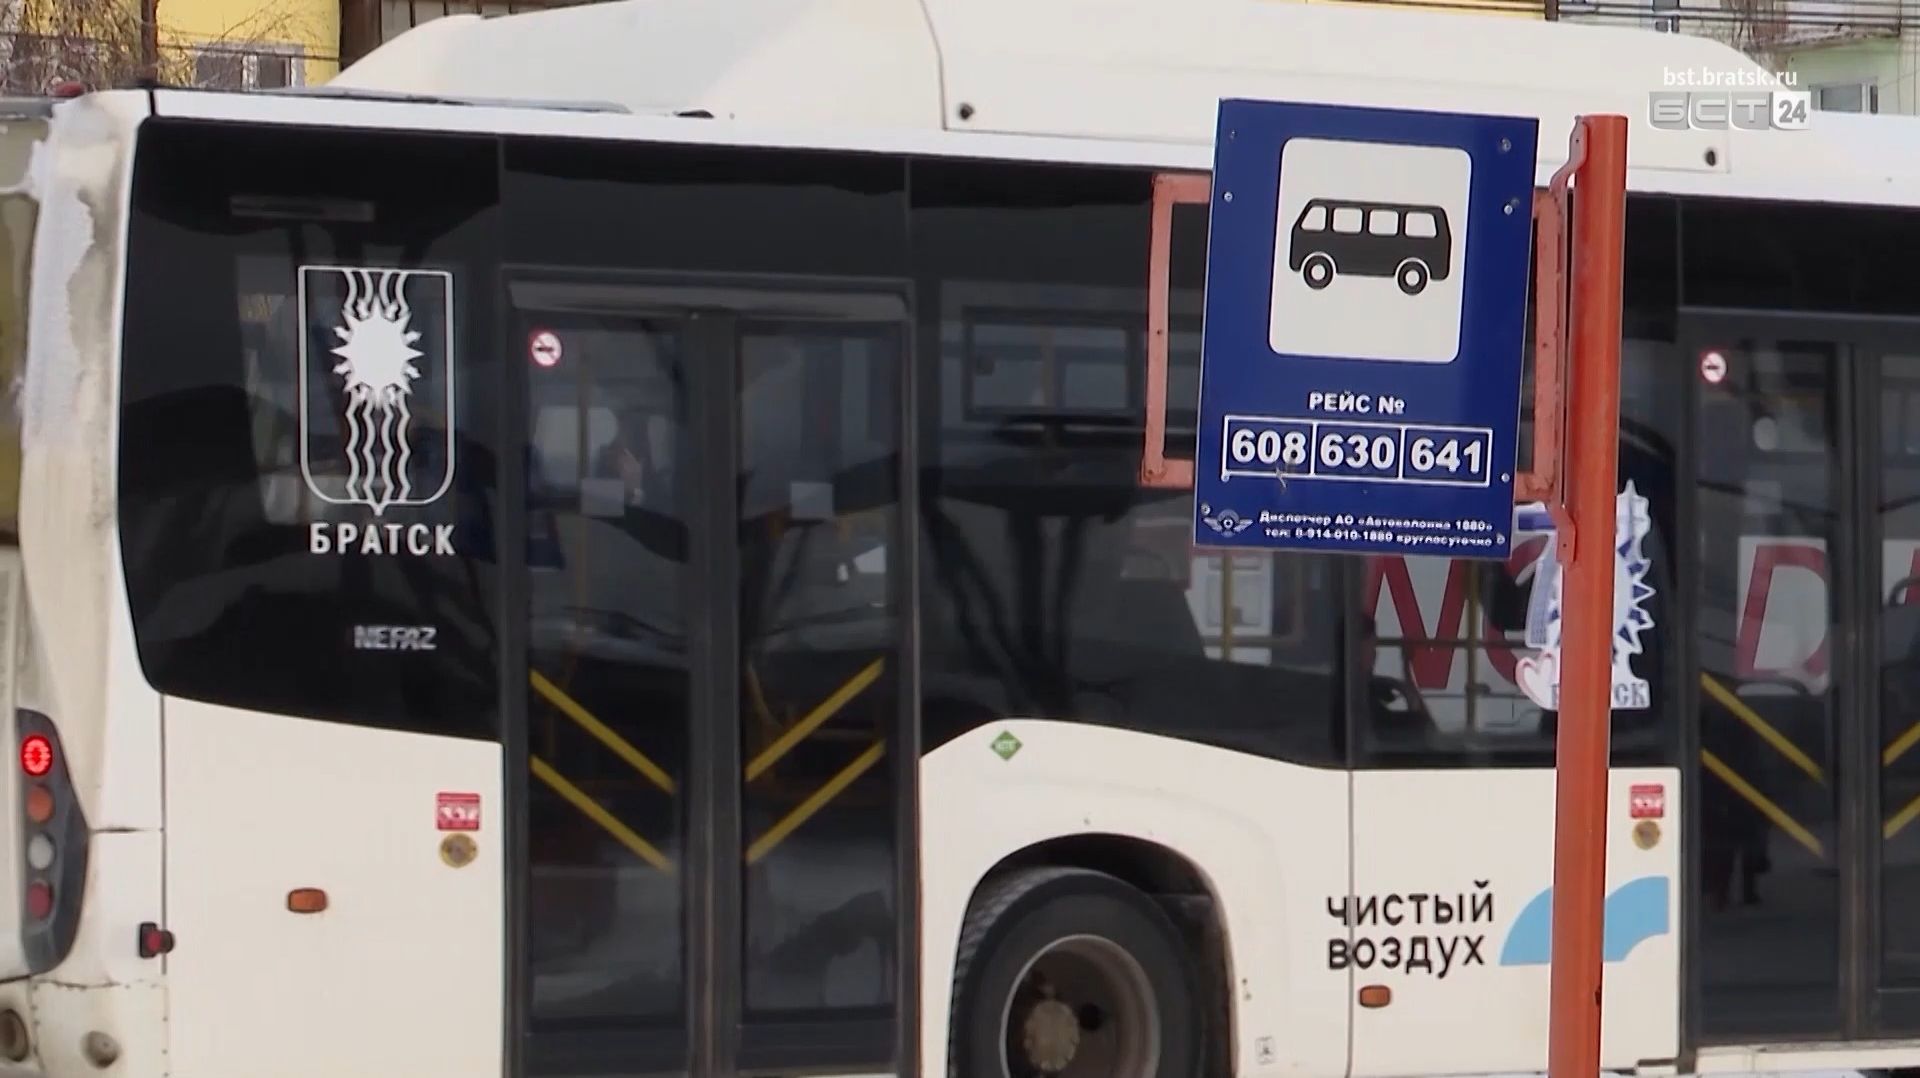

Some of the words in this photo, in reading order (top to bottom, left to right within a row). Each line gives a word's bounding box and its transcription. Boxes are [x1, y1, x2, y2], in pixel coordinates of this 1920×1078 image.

[1308, 390, 1371, 414] РЕЙС
[1378, 396, 1405, 415] №
[1231, 428, 1307, 465] 608
[1320, 432, 1396, 470] 630
[1411, 436, 1481, 474] 641
[1259, 509, 1332, 526] Диспетчер
[1335, 513, 1355, 526] АО
[309, 521, 456, 557] БРАТСК
[1396, 533, 1493, 548] круглосуточно
[353, 624, 438, 651] NEFAZ
